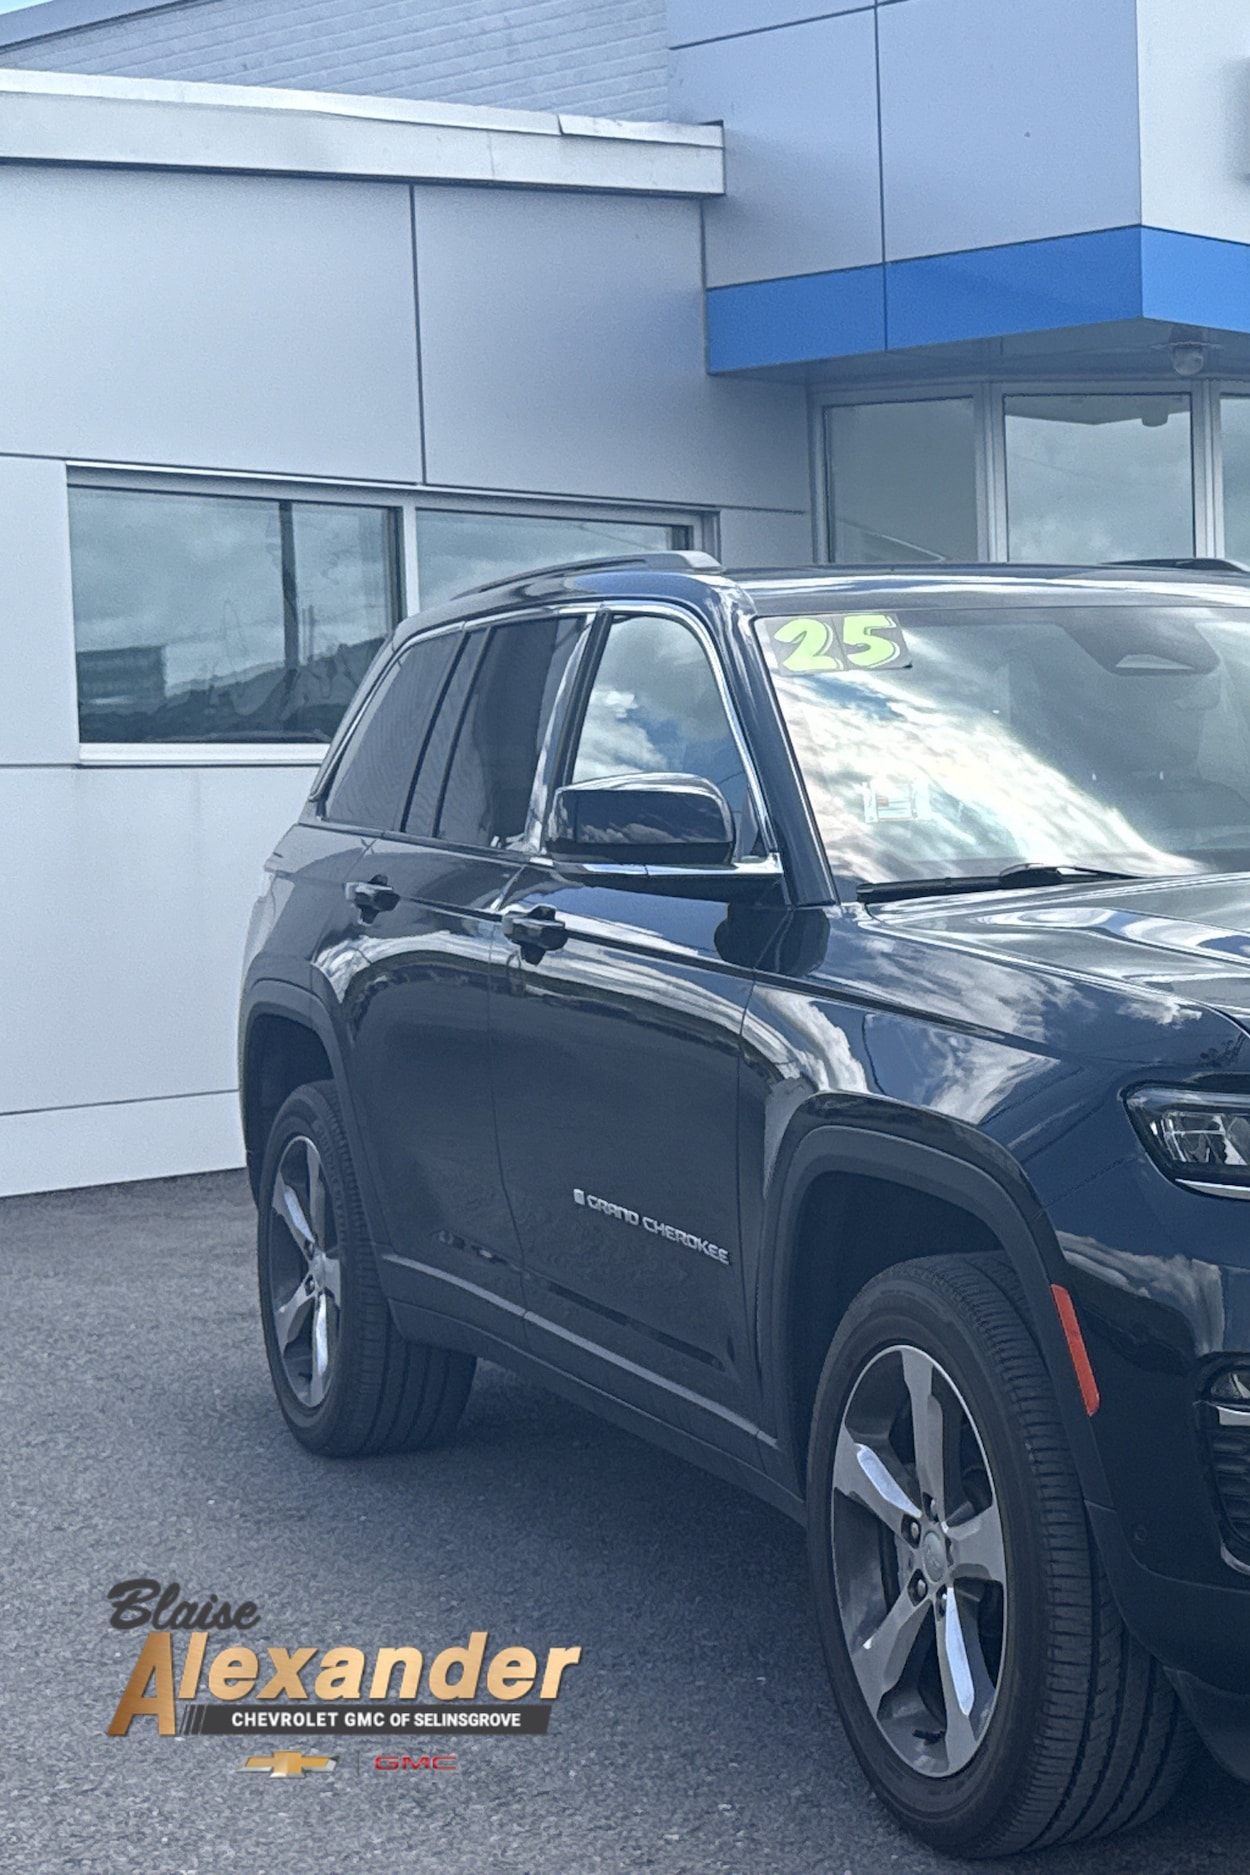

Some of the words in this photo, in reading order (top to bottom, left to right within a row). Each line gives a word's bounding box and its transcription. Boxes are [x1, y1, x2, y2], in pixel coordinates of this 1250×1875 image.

[774, 612, 901, 672] 25
[586, 1193, 640, 1226] GRAND
[641, 1215, 730, 1266] CHEROKEE
